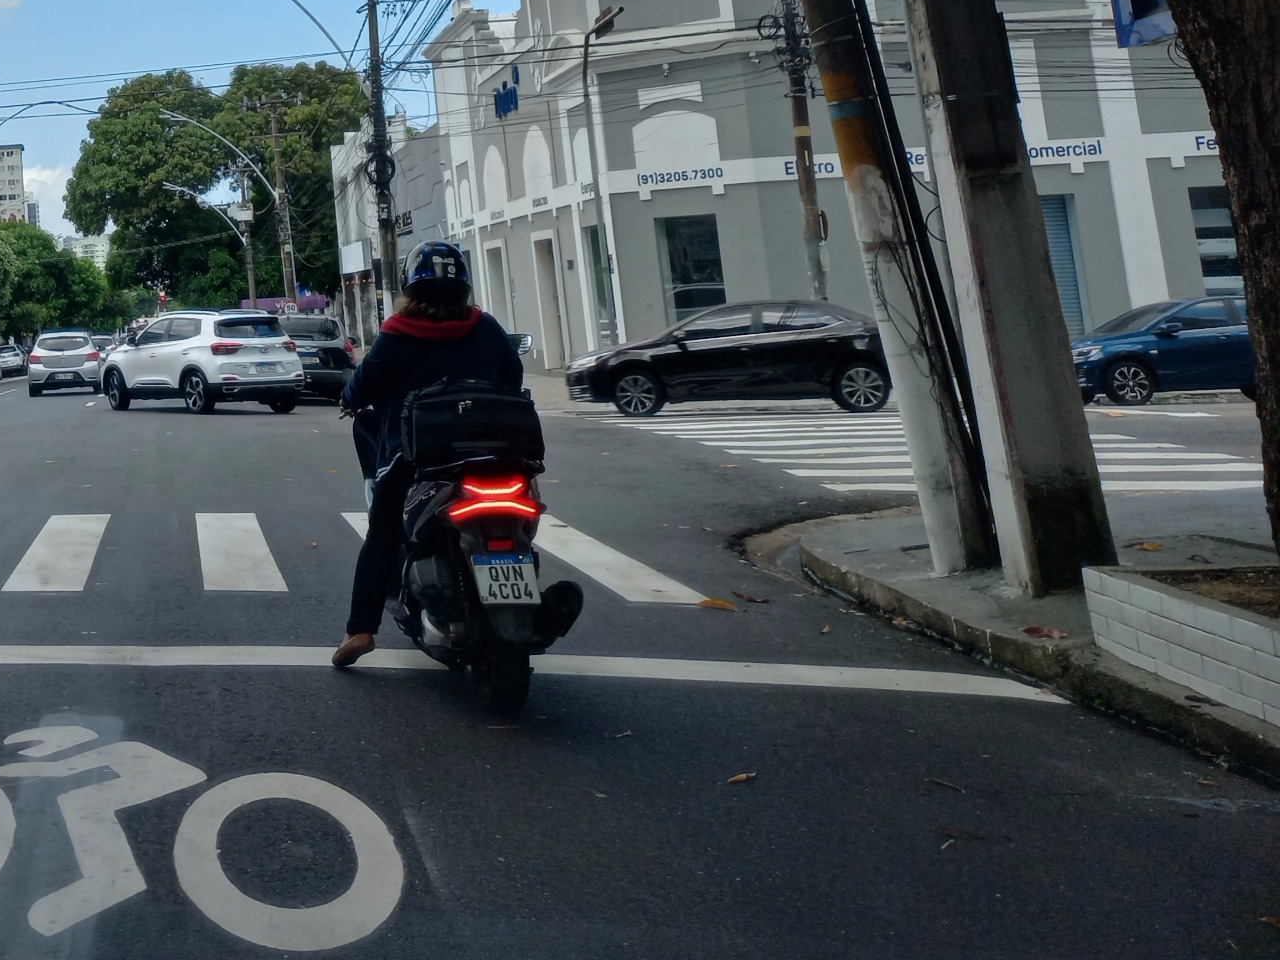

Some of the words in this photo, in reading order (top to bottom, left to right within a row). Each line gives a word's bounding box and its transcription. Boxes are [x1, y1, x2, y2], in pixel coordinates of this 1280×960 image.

[637, 167, 724, 186] (91)3205.7300
[784, 160, 835, 176] Eltro
[488, 565, 525, 582] QVN
